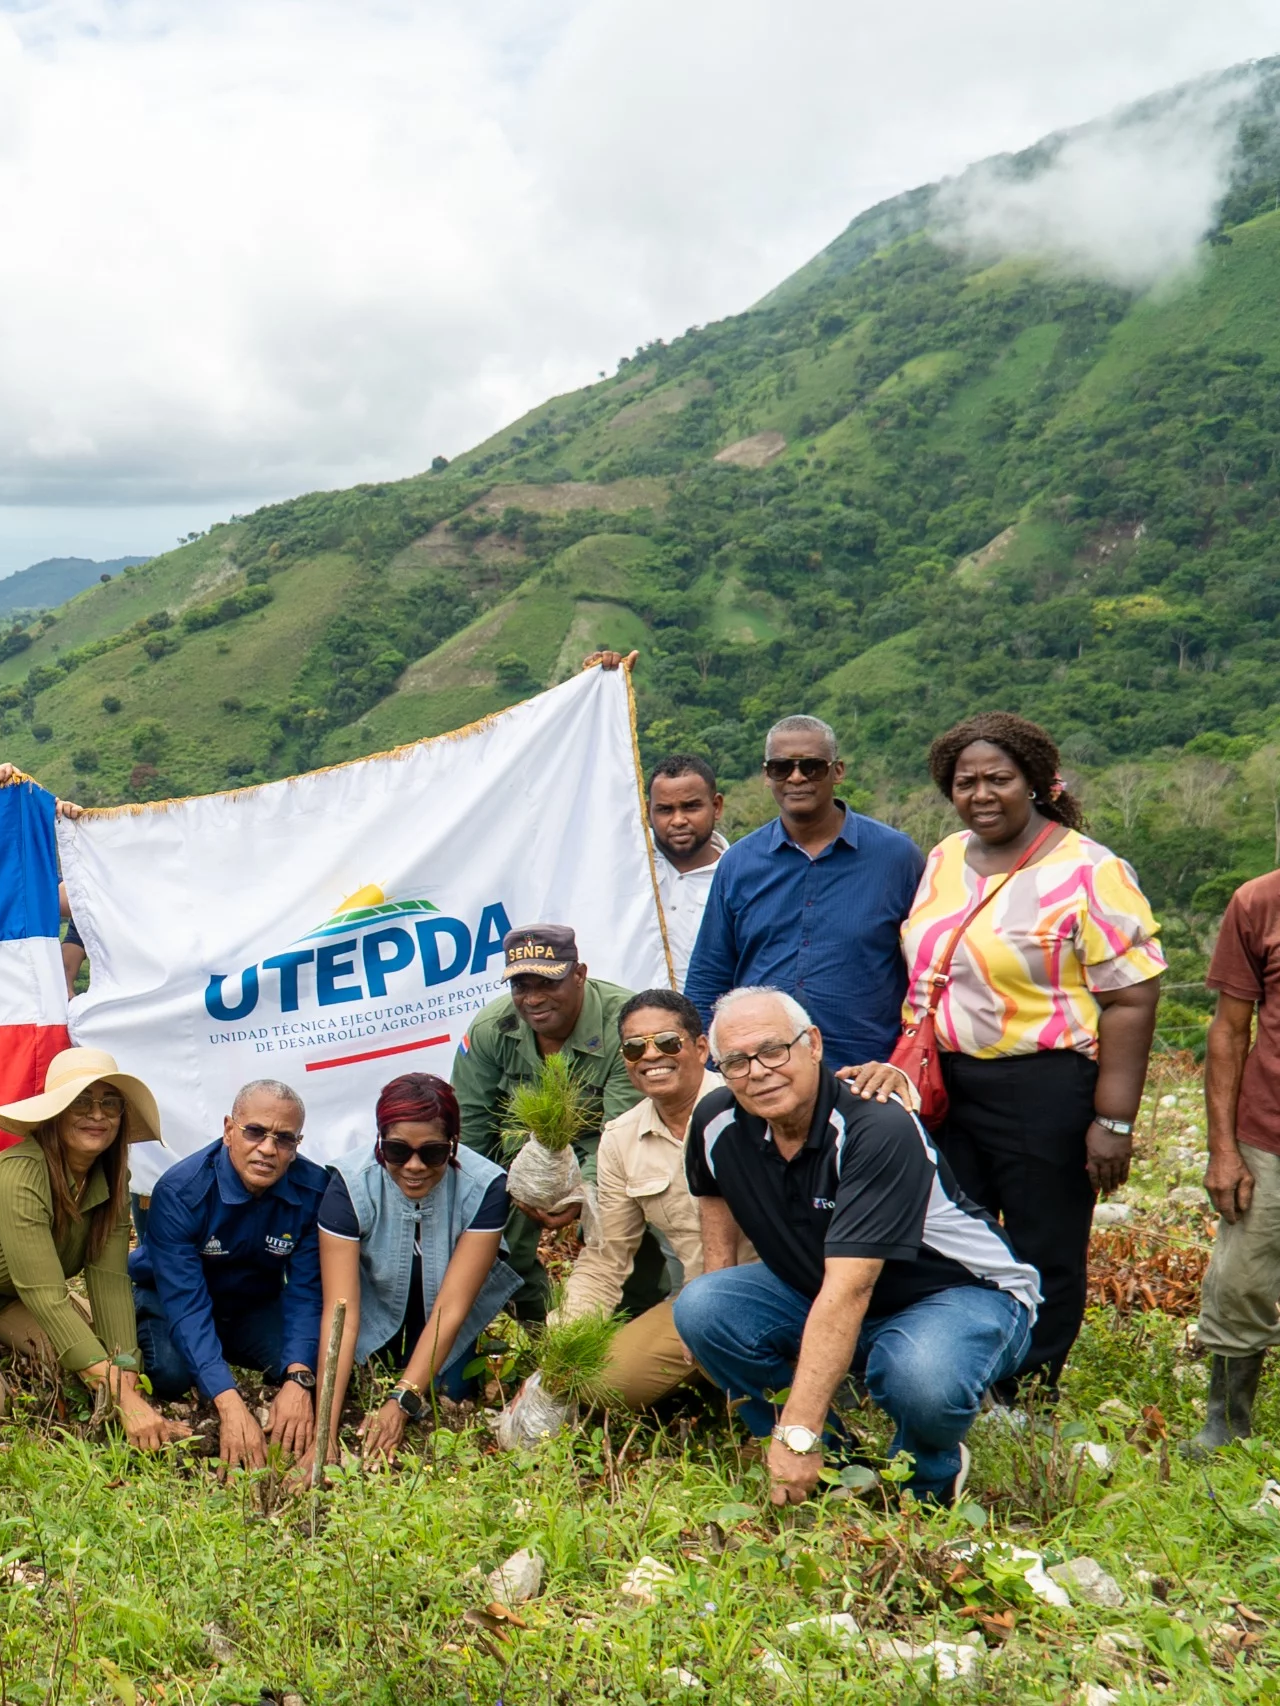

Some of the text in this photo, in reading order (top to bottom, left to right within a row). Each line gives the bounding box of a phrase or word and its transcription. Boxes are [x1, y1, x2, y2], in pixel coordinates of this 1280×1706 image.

[205, 901, 512, 1021] UTEPDA
[509, 946, 555, 961] SENPA
[209, 1028, 268, 1045] UNIDAD
[272, 1018, 337, 1037] TÉCNICA
[341, 1002, 424, 1027] EJECUTORA
[428, 995, 445, 1008] DE
[256, 1041, 274, 1053] DE
[279, 1025, 376, 1050] DESARROLLO
